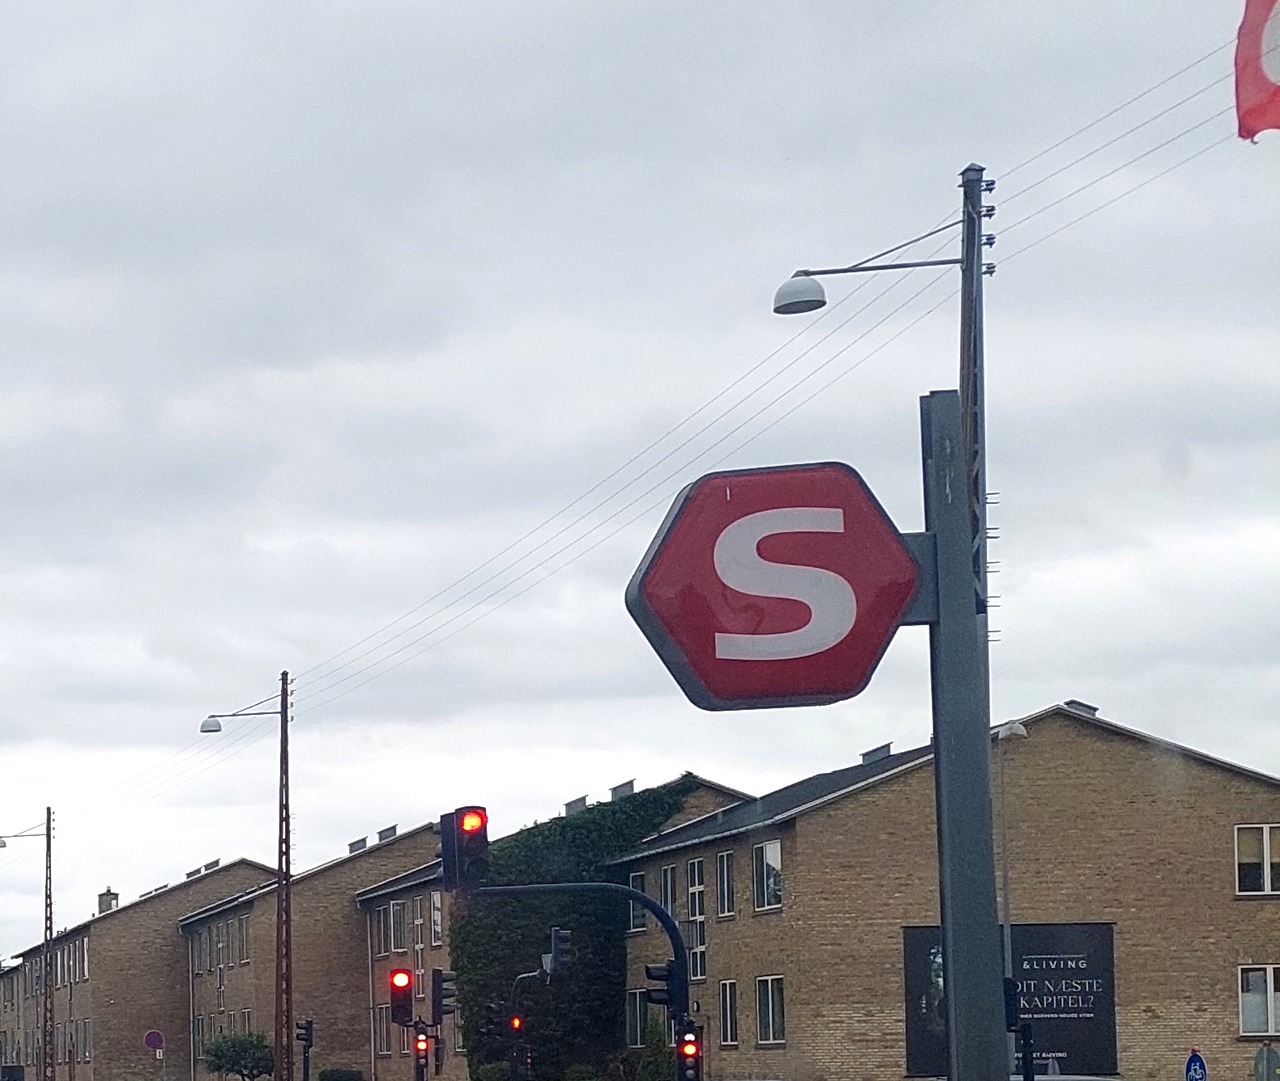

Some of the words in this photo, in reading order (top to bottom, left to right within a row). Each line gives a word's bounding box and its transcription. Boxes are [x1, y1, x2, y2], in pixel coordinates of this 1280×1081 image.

[714, 507, 857, 660] S
[1022, 960, 1088, 969] &LIVING
[1044, 980, 1103, 992] NÆSTE
[1020, 996, 1095, 1008] KAPITEL?
